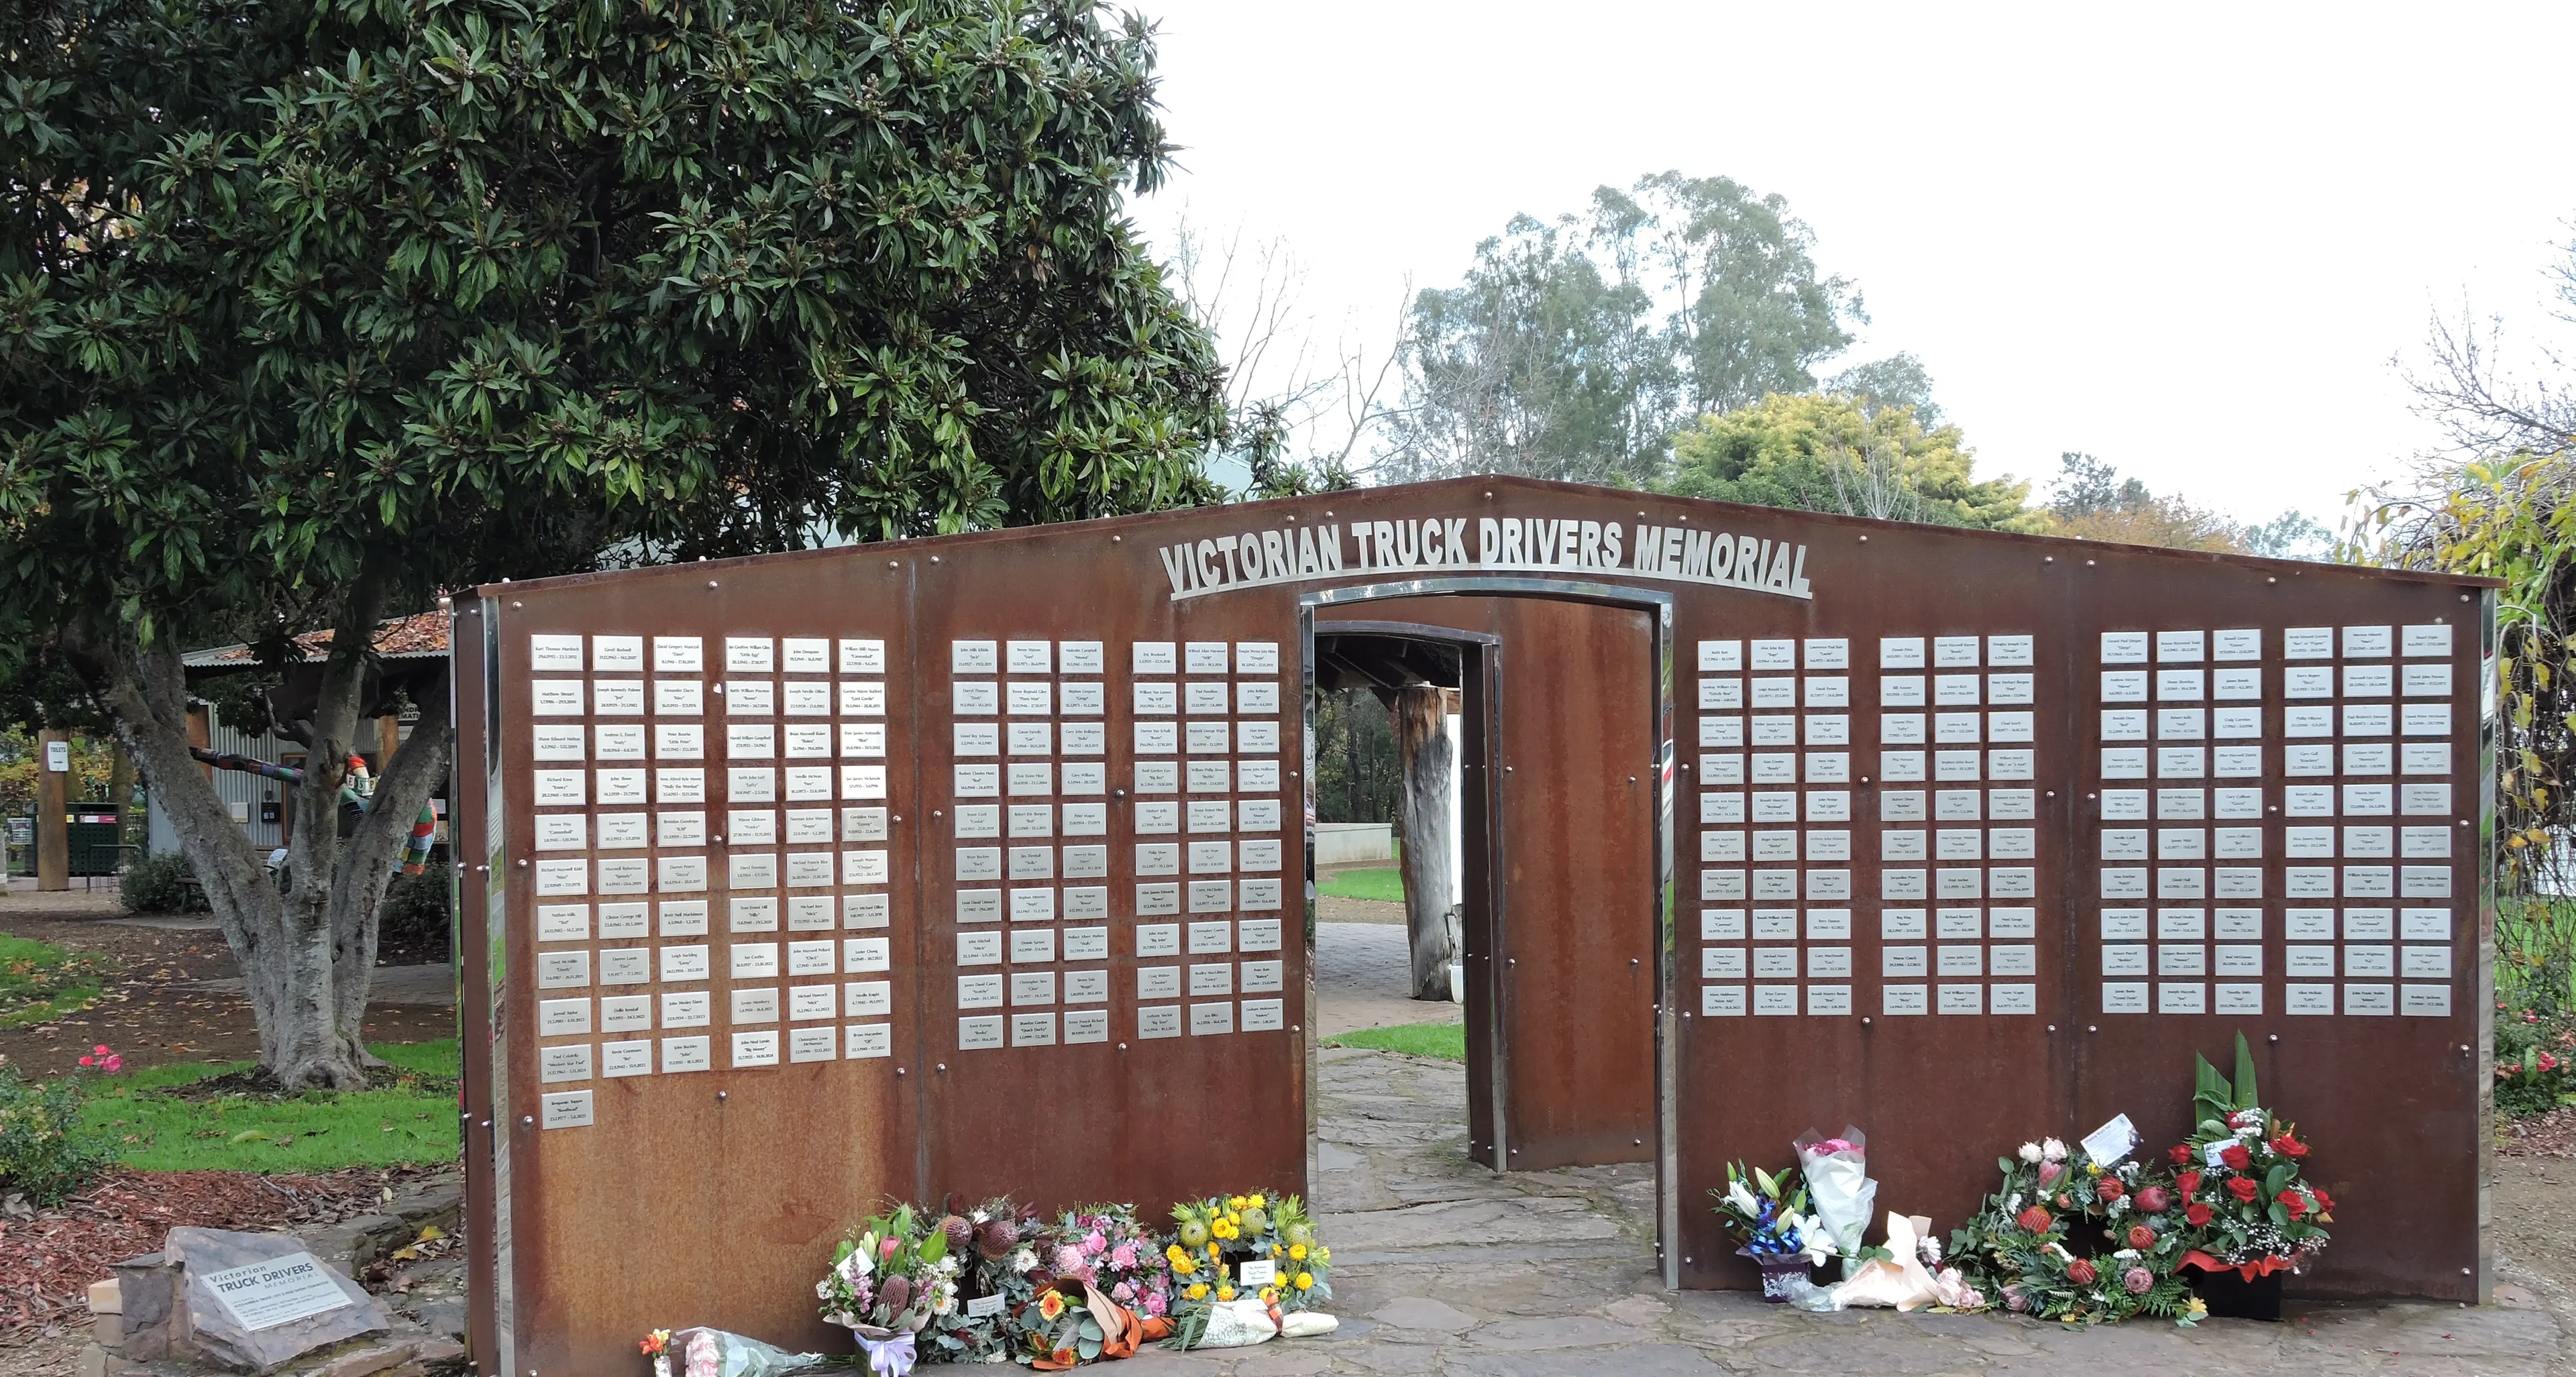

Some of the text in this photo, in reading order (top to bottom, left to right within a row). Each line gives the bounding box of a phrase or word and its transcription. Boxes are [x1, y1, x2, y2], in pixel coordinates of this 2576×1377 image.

[1159, 518, 1811, 597] VICTORIAN TRUCK DRIVERS MEMORIAL
[209, 1266, 267, 1282] Victorian
[217, 1262, 313, 1292] TRUCK DRIVERS
[264, 1273, 319, 1289] MEMORIAL
